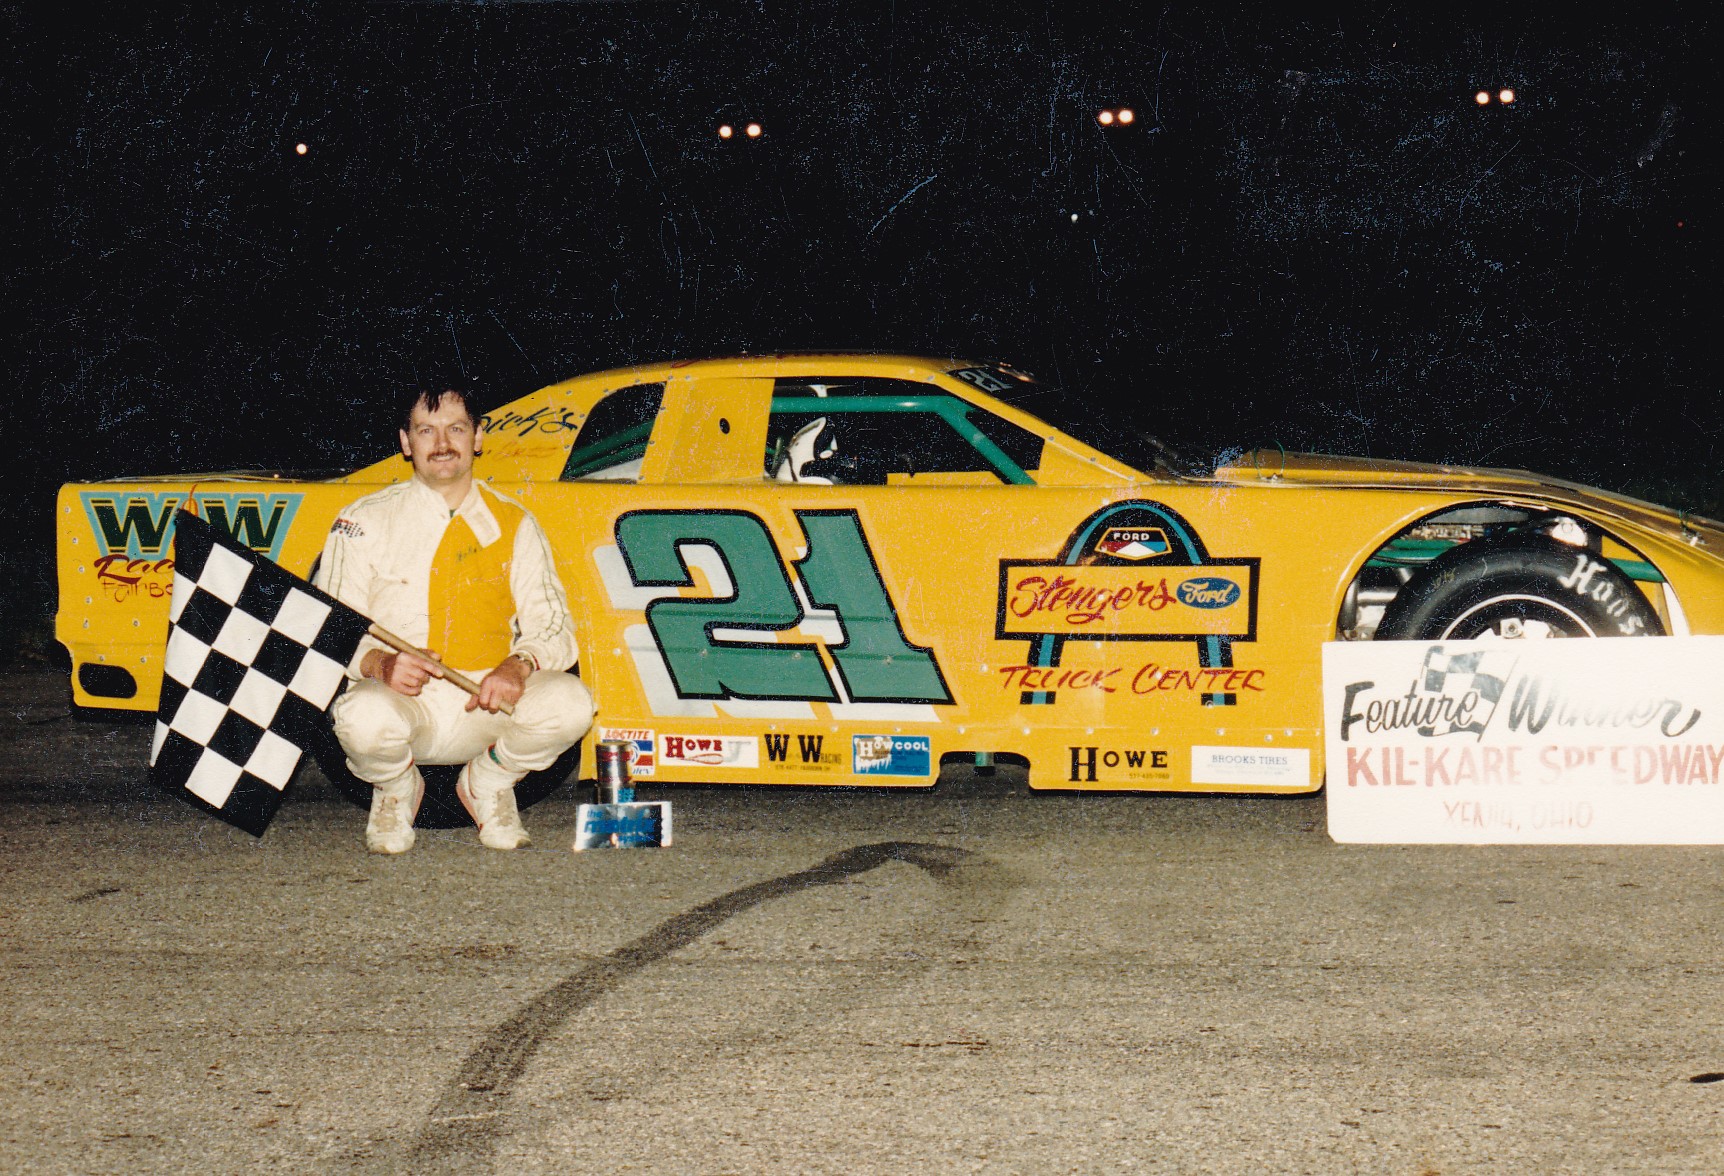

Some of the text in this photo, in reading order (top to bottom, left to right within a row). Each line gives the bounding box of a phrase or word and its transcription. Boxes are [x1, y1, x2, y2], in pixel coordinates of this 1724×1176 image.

[1113, 532, 1150, 541] FORD
[94, 554, 174, 585] Rac
[613, 508, 957, 705] 21
[1010, 574, 1176, 624] Stengers
[1181, 582, 1231, 604] Ford
[1557, 554, 1648, 636] Hoos
[1000, 664, 1265, 694] TRUCK CENTER
[1341, 673, 1701, 741] Feature Winner
[605, 729, 649, 740] LOCTITE
[665, 736, 723, 758] HOWE
[1069, 747, 1168, 782] HOWE
[1212, 754, 1288, 765] BROOKS TIRES
[1347, 746, 1525, 787] KIL-KARE
